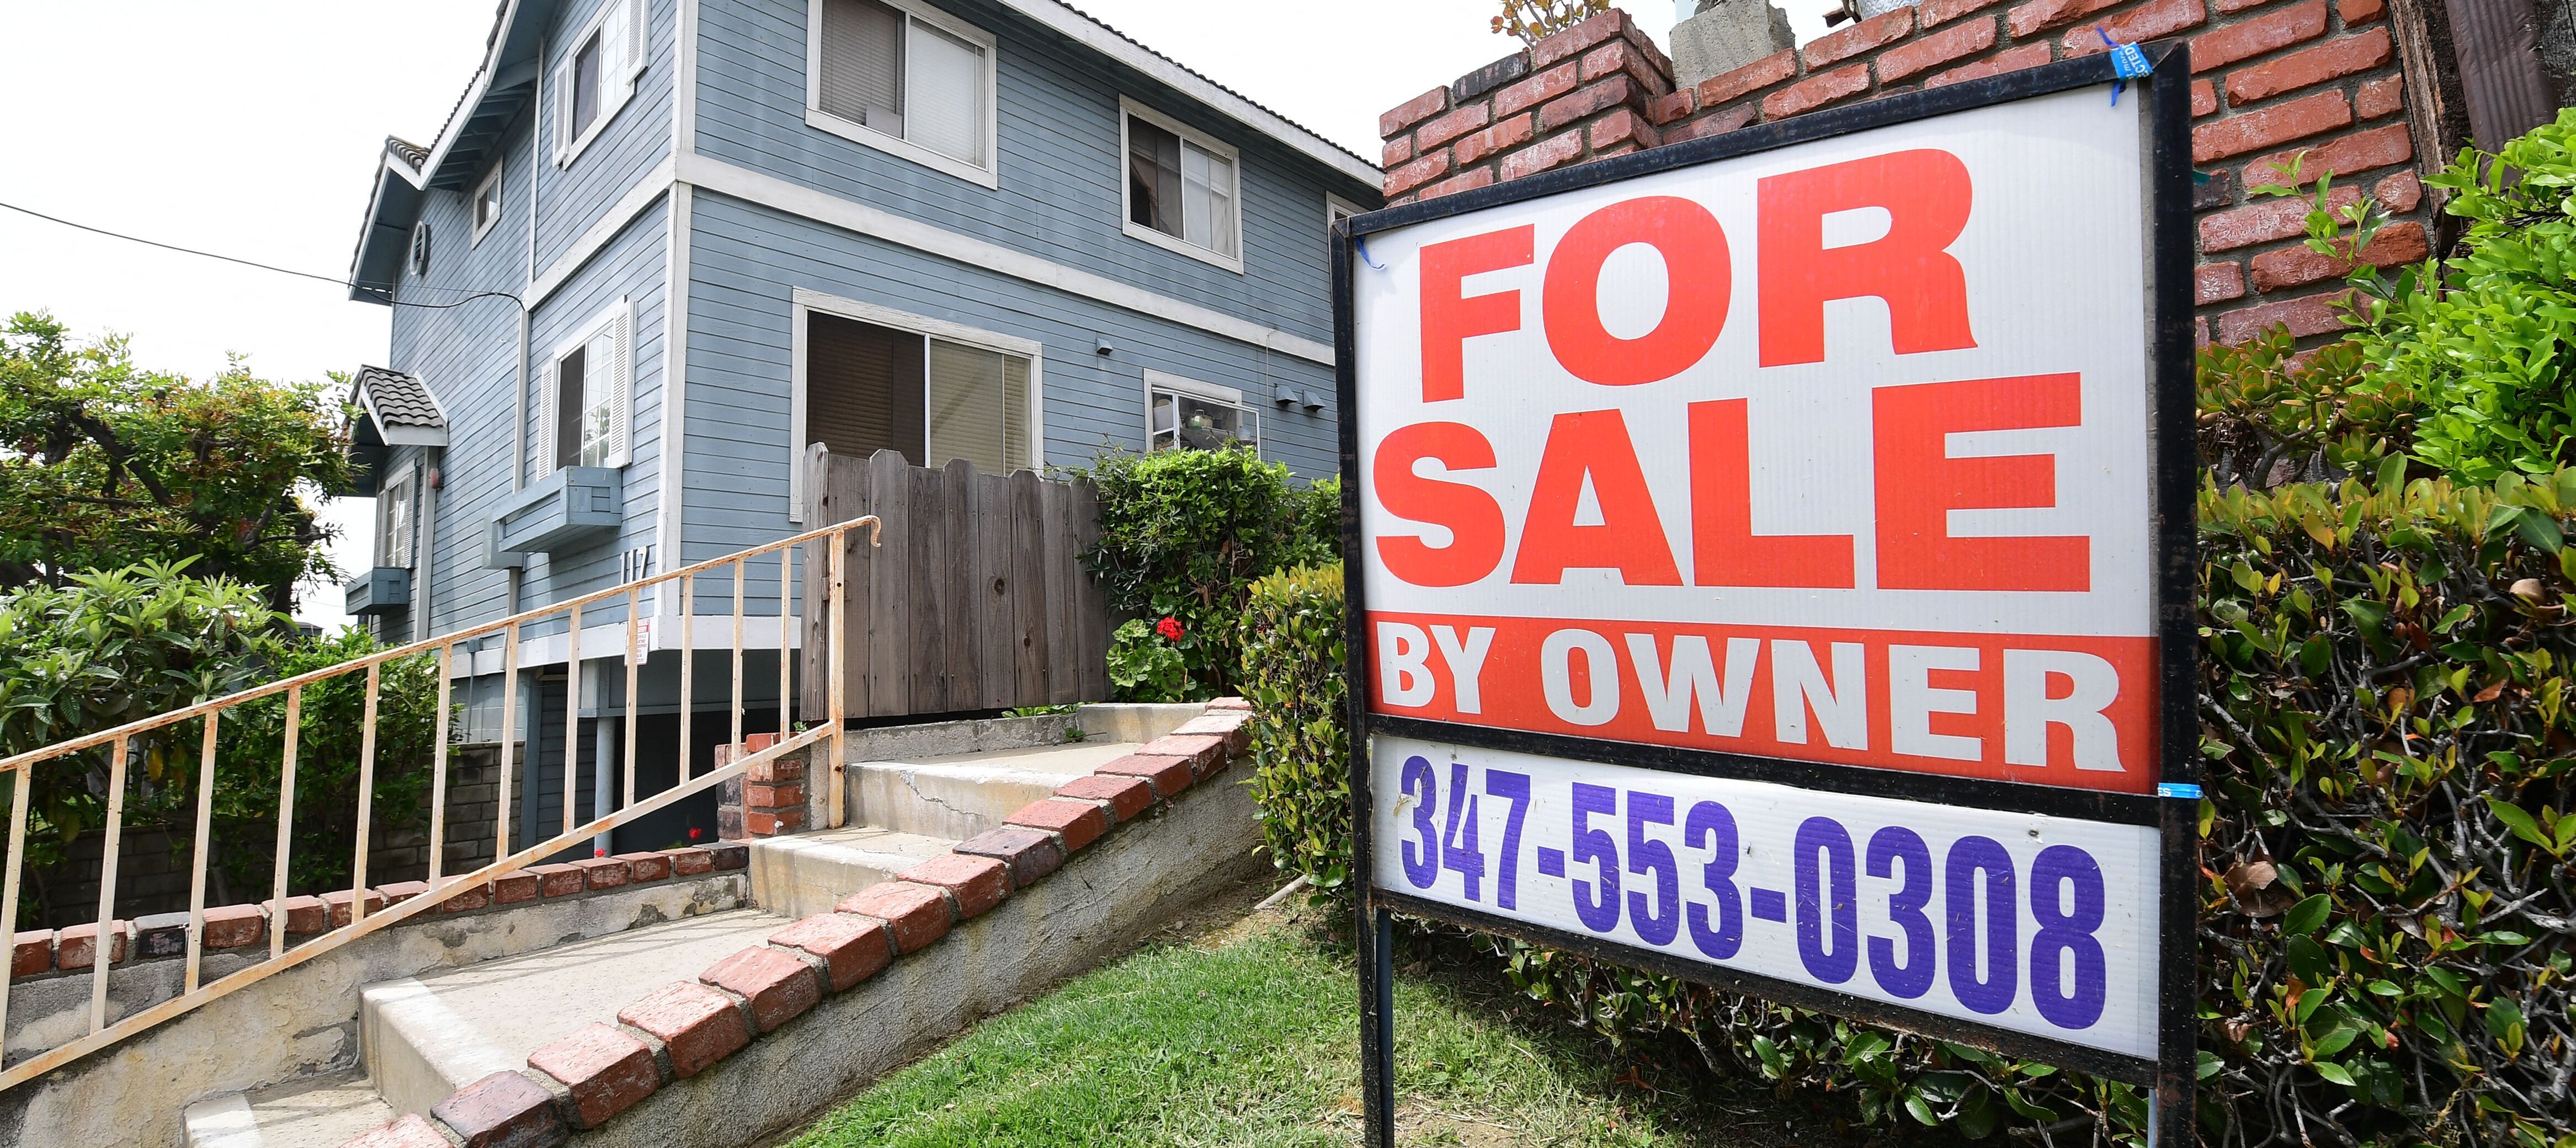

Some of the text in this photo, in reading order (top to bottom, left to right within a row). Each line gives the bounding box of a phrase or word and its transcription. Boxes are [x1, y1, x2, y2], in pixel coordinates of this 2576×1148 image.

[1420, 149, 1978, 403] FOR
[620, 546, 648, 585] 117
[1374, 372, 2090, 592] SALE
[1377, 622, 2125, 772] BY OWNER
[1401, 756, 2106, 1029] 347-553-0308
